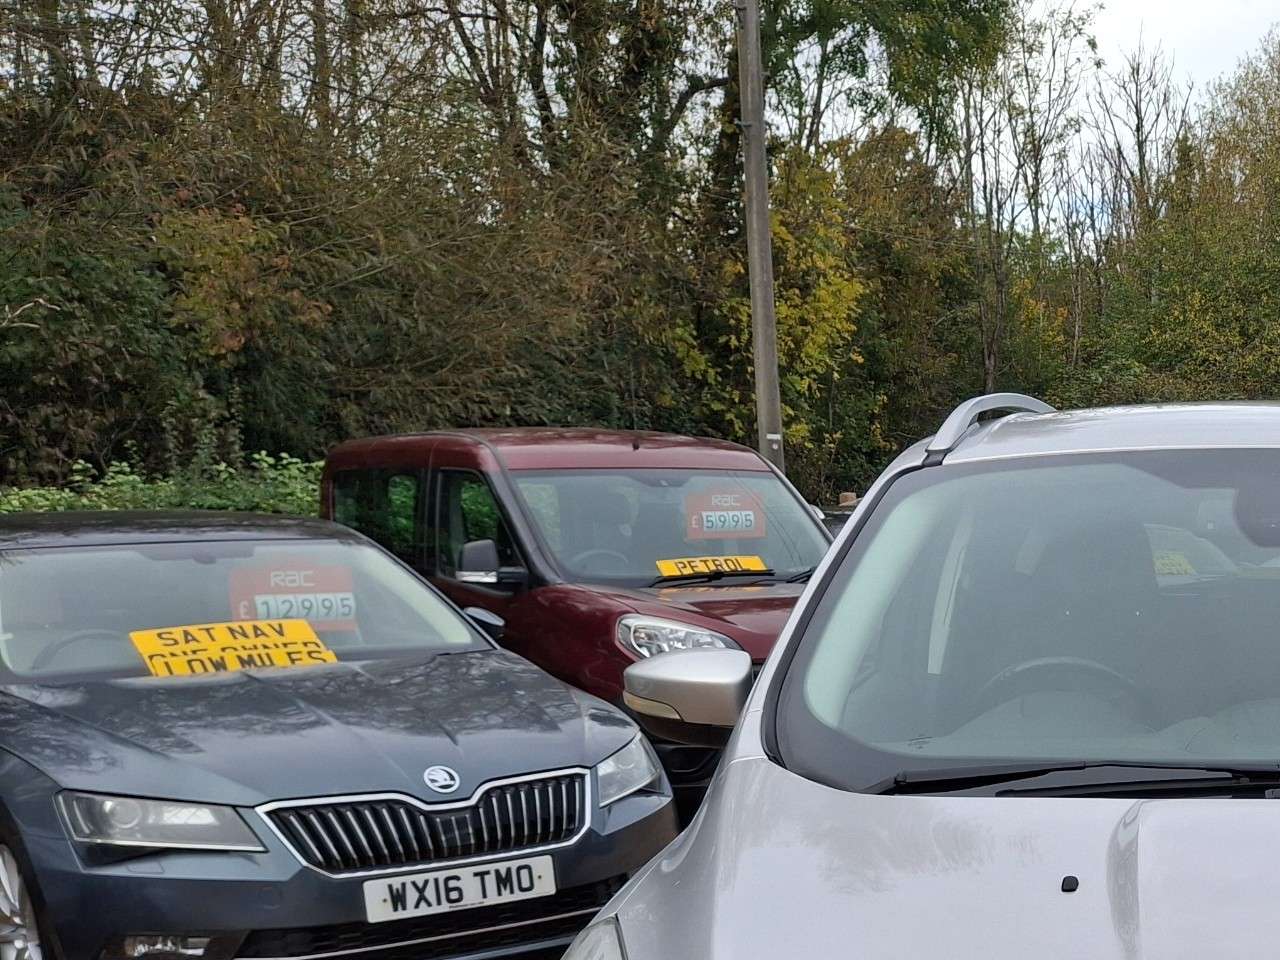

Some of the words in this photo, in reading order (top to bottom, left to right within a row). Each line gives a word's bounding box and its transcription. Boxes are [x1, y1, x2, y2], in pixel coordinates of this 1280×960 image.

[674, 558, 744, 575] PETROL
[157, 627, 217, 647] SAT
[226, 622, 286, 640] NAV
[387, 875, 464, 912] WX16
[473, 864, 535, 899] TMO
